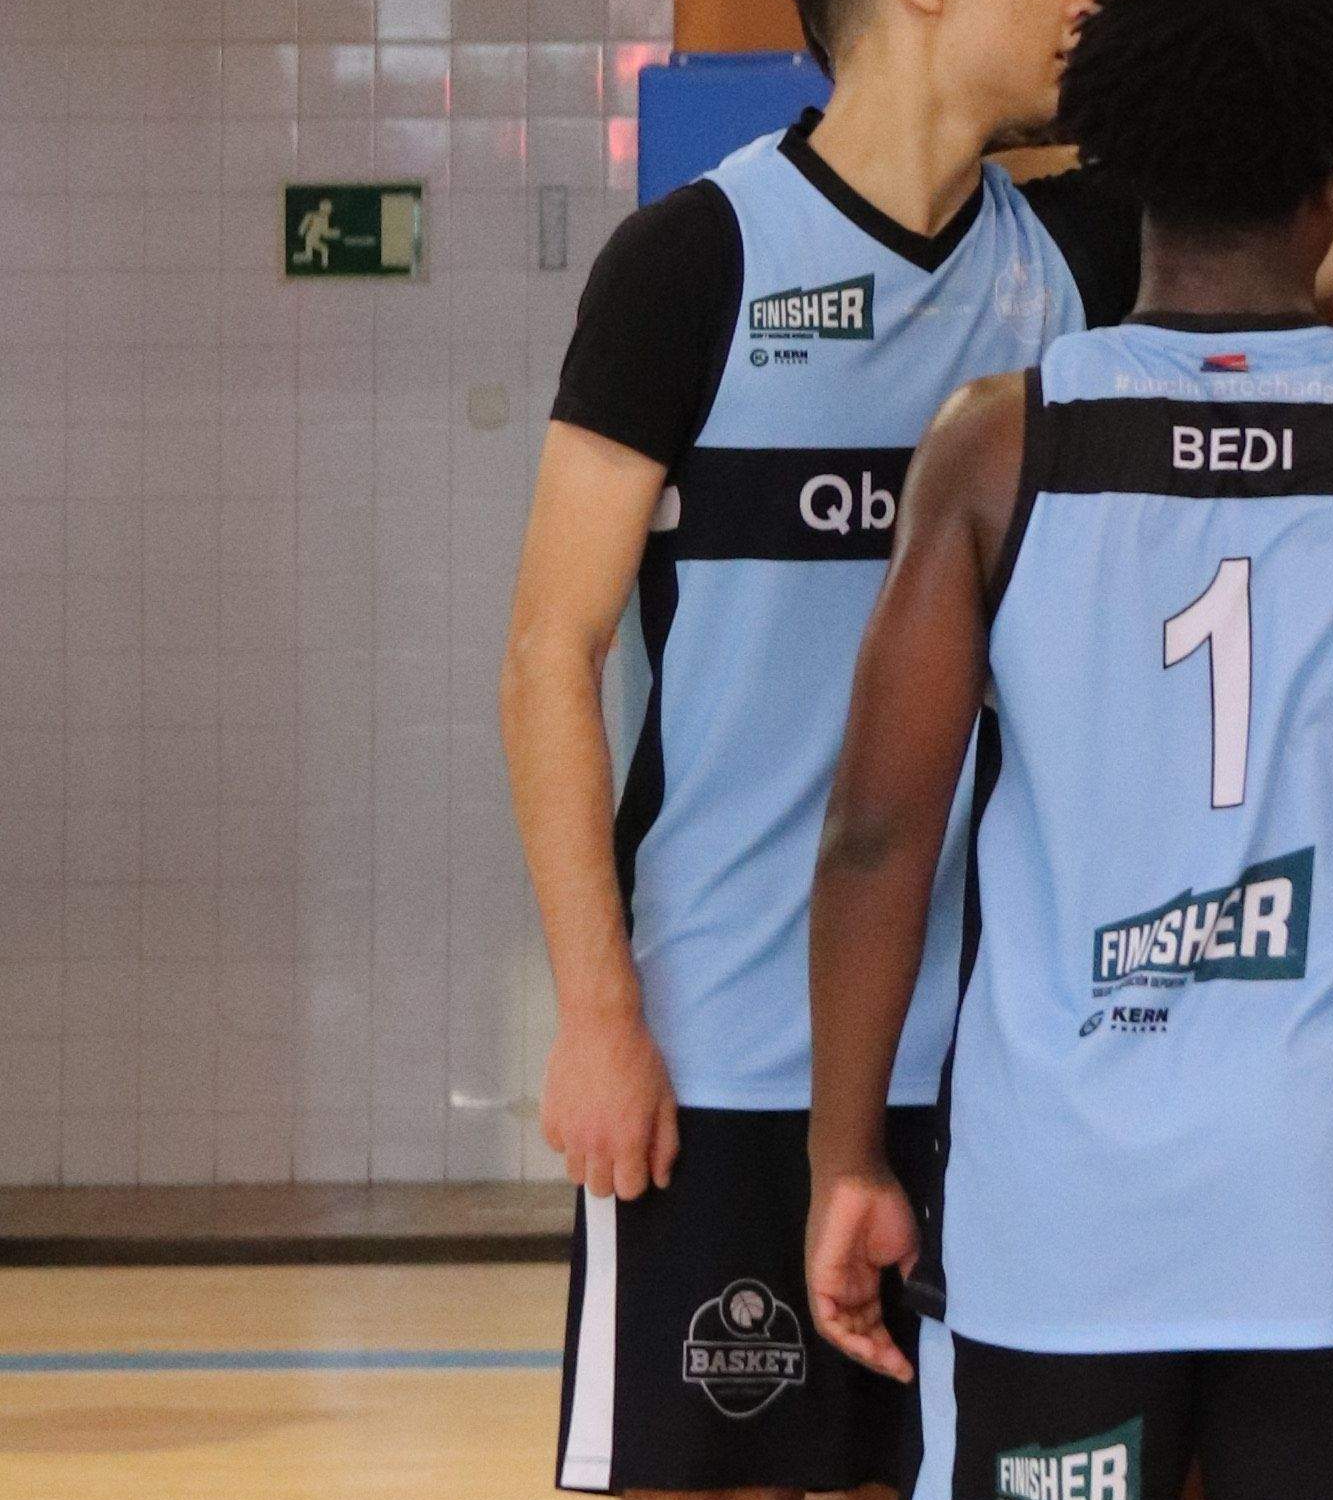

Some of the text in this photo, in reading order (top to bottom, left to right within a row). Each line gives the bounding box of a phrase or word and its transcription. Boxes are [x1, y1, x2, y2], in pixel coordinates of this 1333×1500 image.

[753, 287, 865, 330] FINISHER
[1172, 424, 1294, 472] BEDI
[1162, 556, 1253, 812] 1
[1100, 876, 1293, 978] FINISHER
[1111, 1005, 1169, 1024] KERN
[689, 1347, 801, 1375] BASKET
